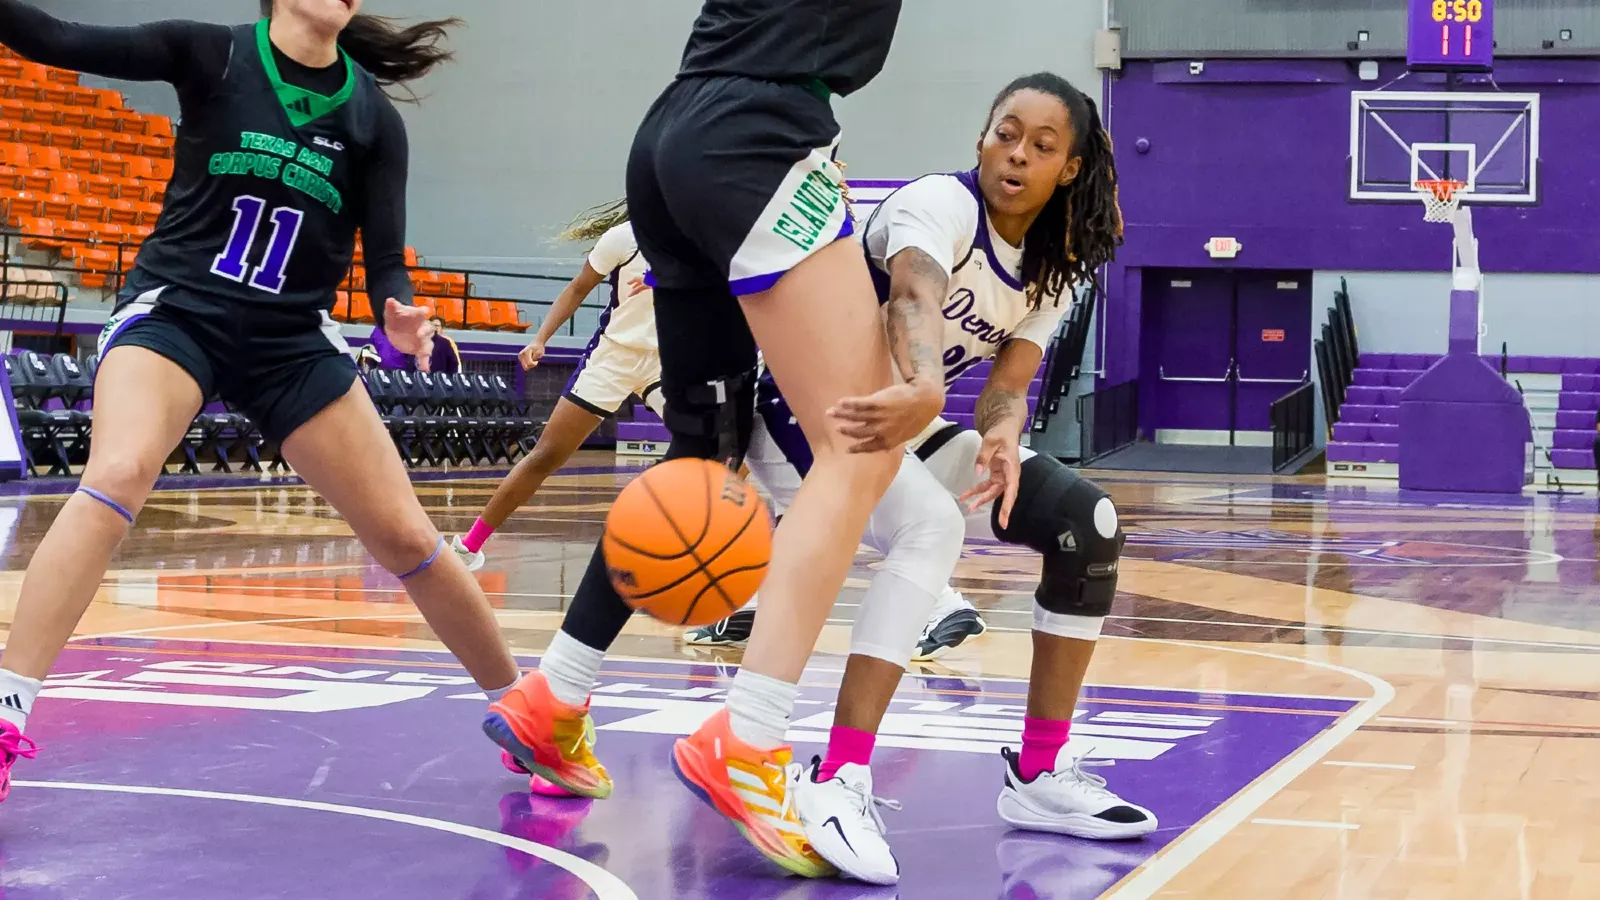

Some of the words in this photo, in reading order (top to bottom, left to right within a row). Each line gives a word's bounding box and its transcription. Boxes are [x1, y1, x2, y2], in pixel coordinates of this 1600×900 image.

[1432, 0, 1482, 22] 8:50
[1441, 24, 1472, 56] 11
[208, 152, 282, 179] CORPUS
[240, 131, 297, 158] TEXAS
[297, 147, 334, 176] A&M
[772, 162, 839, 252] ISLANDER
[209, 195, 305, 295] 11
[1215, 239, 1232, 252] EXIT
[942, 287, 1012, 348] Demo
